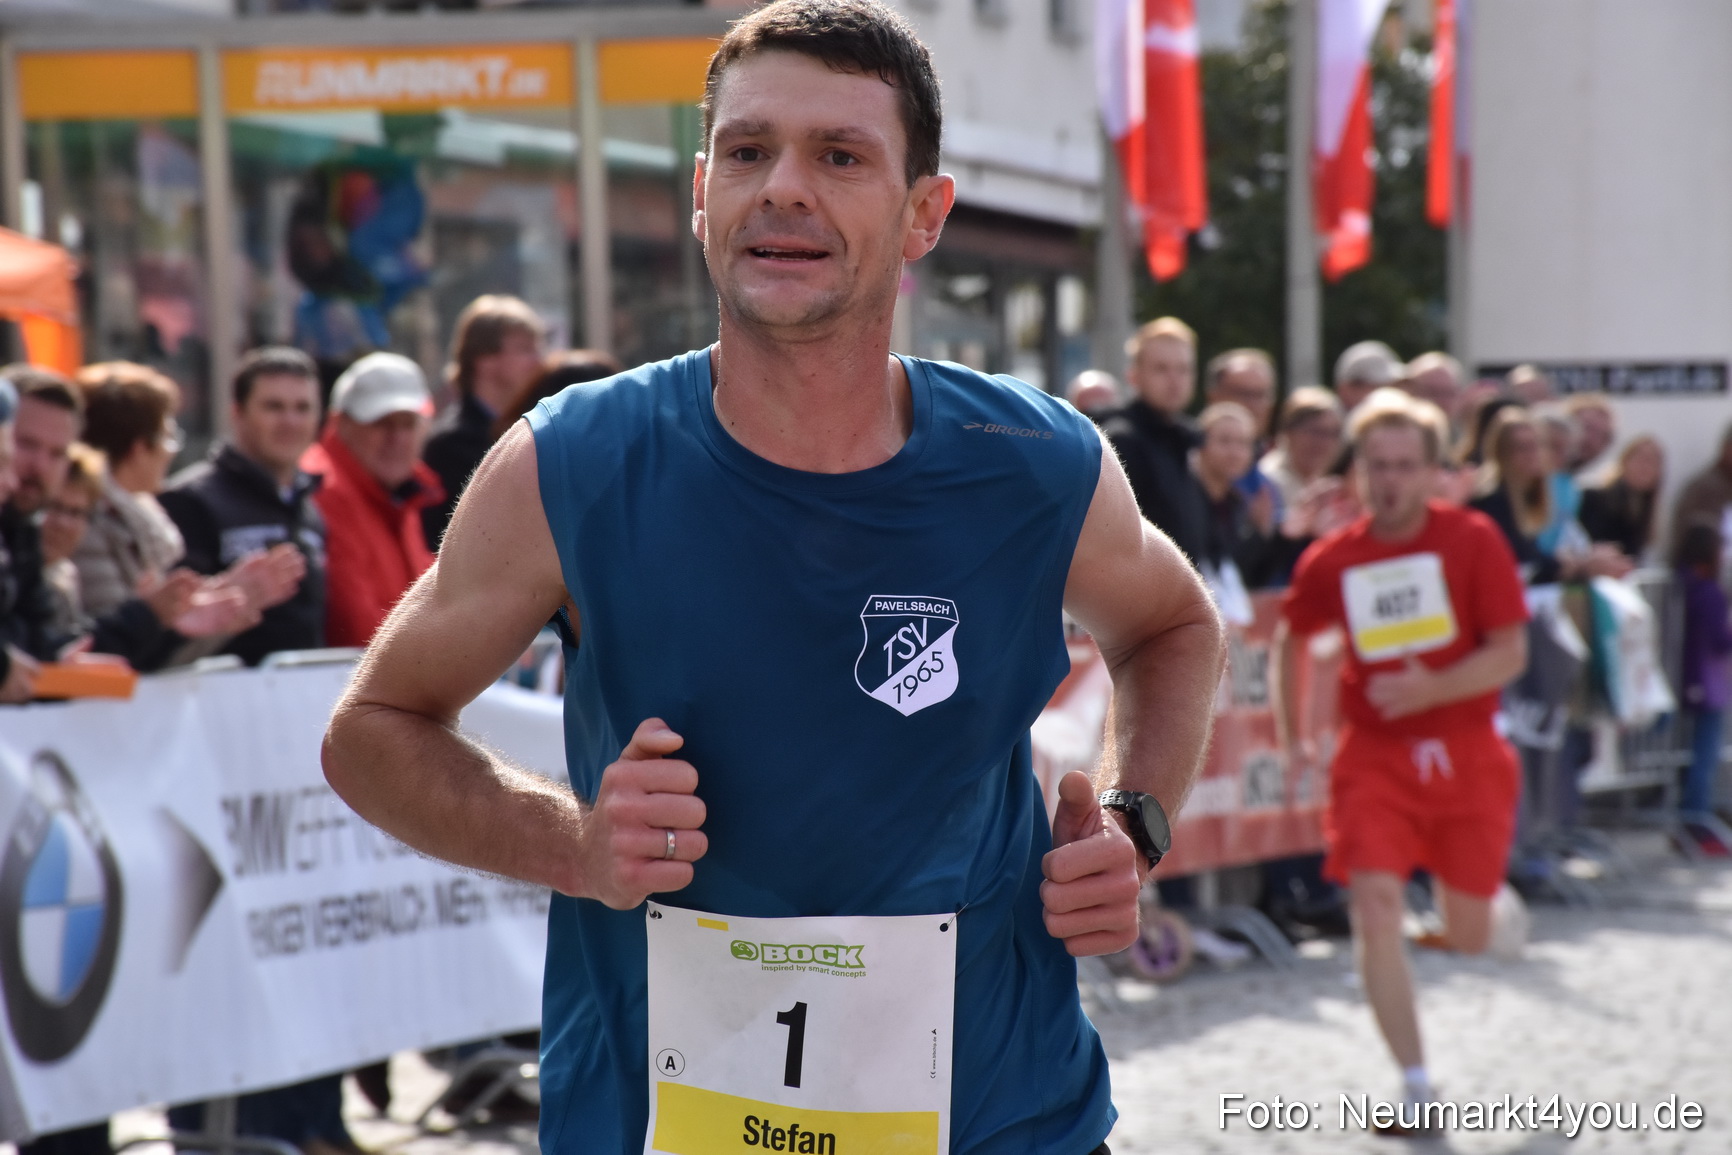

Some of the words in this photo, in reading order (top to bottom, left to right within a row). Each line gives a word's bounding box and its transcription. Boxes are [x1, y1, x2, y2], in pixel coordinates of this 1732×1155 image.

[983, 423, 1054, 440] BROOKS
[875, 601, 951, 615] PAVELSBACH
[883, 617, 928, 677] TSV
[892, 651, 945, 704] 1965
[760, 943, 866, 969] BOCK
[761, 964, 794, 973] inspired
[796, 964, 806, 973] by
[808, 966, 830, 976] smart
[831, 969, 867, 979] concepts
[776, 1001, 808, 1089] 1
[664, 1055, 677, 1071] A
[742, 1114, 836, 1155] Stefan
